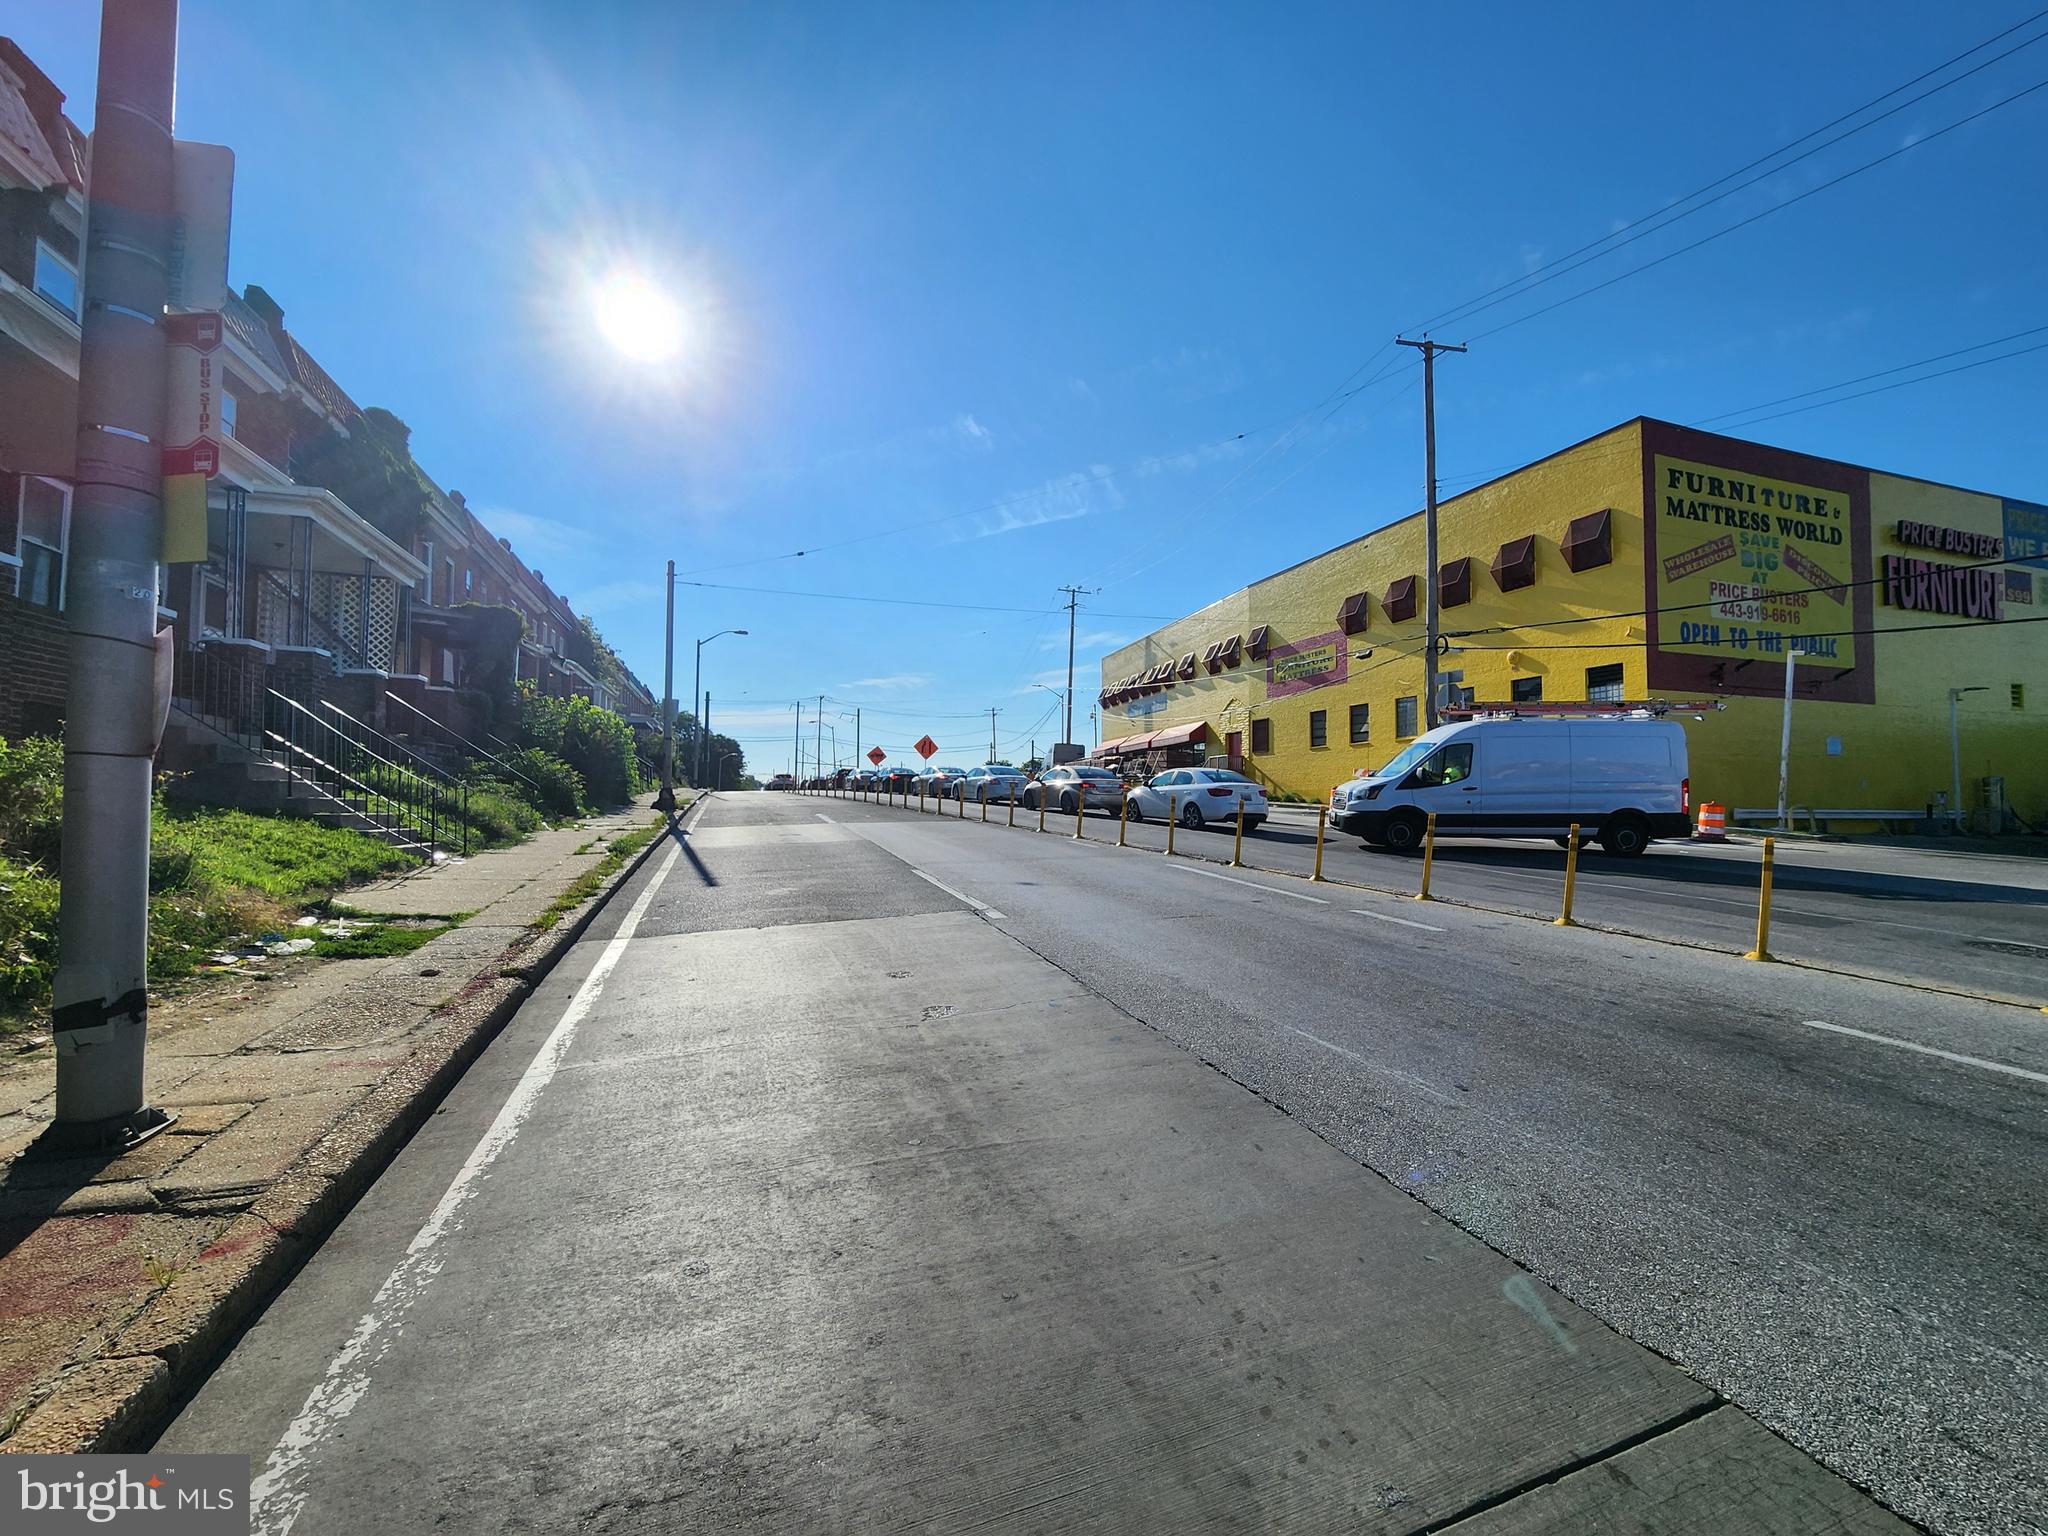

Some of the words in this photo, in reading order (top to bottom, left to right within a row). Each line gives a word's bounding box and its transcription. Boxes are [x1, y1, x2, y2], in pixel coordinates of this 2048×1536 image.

[199, 358, 211, 388] BUS
[199, 392, 210, 433] STOP
[1667, 468, 1828, 518] FURNITURE
[1666, 496, 1771, 534] MATTRESS
[1776, 516, 1843, 546] WORLD
[1665, 536, 1732, 568] WHOLESALE
[1901, 520, 1943, 548] PRICE
[1945, 528, 2005, 560] BUSTERS
[2007, 535, 2037, 557] WE
[1668, 548, 1735, 579] WAREHOUSE
[1740, 549, 1780, 572] BIG
[1751, 571, 1768, 585] AT
[1887, 555, 2005, 621] FURNITURE
[1710, 581, 1748, 599] PRICE
[1752, 586, 1809, 608] BUSTERS
[1720, 603, 1801, 625] 443-919-6616
[1680, 621, 1720, 646] OPEN
[1729, 626, 1748, 650] TO
[1756, 629, 1782, 653] THE
